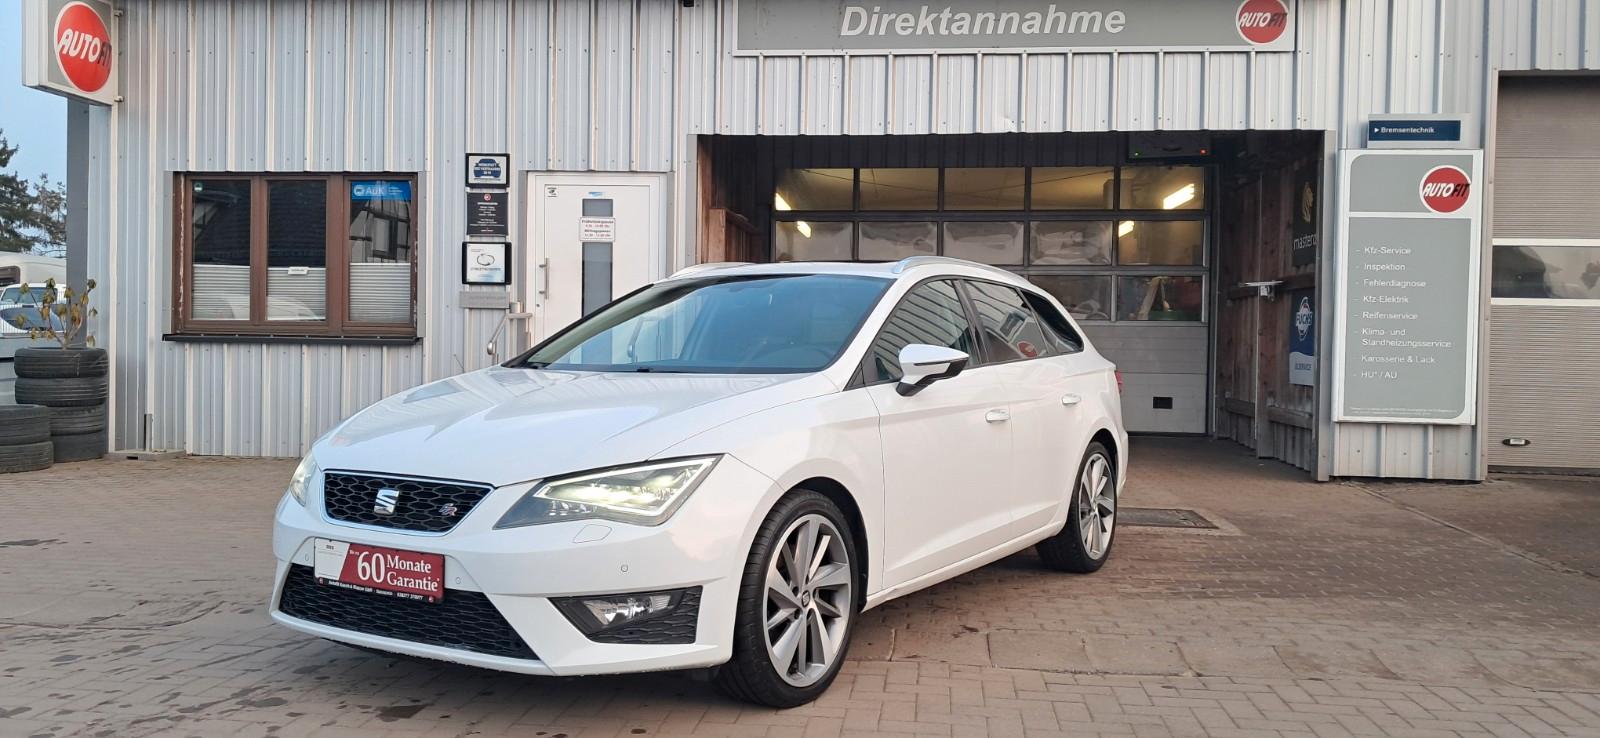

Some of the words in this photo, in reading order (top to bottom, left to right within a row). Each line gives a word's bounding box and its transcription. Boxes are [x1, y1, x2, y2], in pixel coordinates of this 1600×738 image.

[840, 4, 1126, 36] Direktannahme
[1240, 12, 1288, 28] AUTOFIT
[1380, 126, 1435, 134] Bremsentechnik
[1423, 182, 1471, 198] AUTOFIT
[1364, 246, 1412, 255] Kfz-Service
[1364, 263, 1406, 272] Inspektion
[1363, 279, 1427, 289] Fehlerdiagnose
[1363, 295, 1409, 304] Kfz-Elektrik
[1362, 311, 1418, 320] Reifenservice
[1361, 338, 1452, 348] Standheizungsservice
[1361, 354, 1405, 363] Karosserie
[1406, 355, 1414, 363] &
[1415, 355, 1436, 363] Lack
[1384, 371, 1398, 379] AU
[357, 551, 386, 583] 60
[386, 554, 432, 574] Monate
